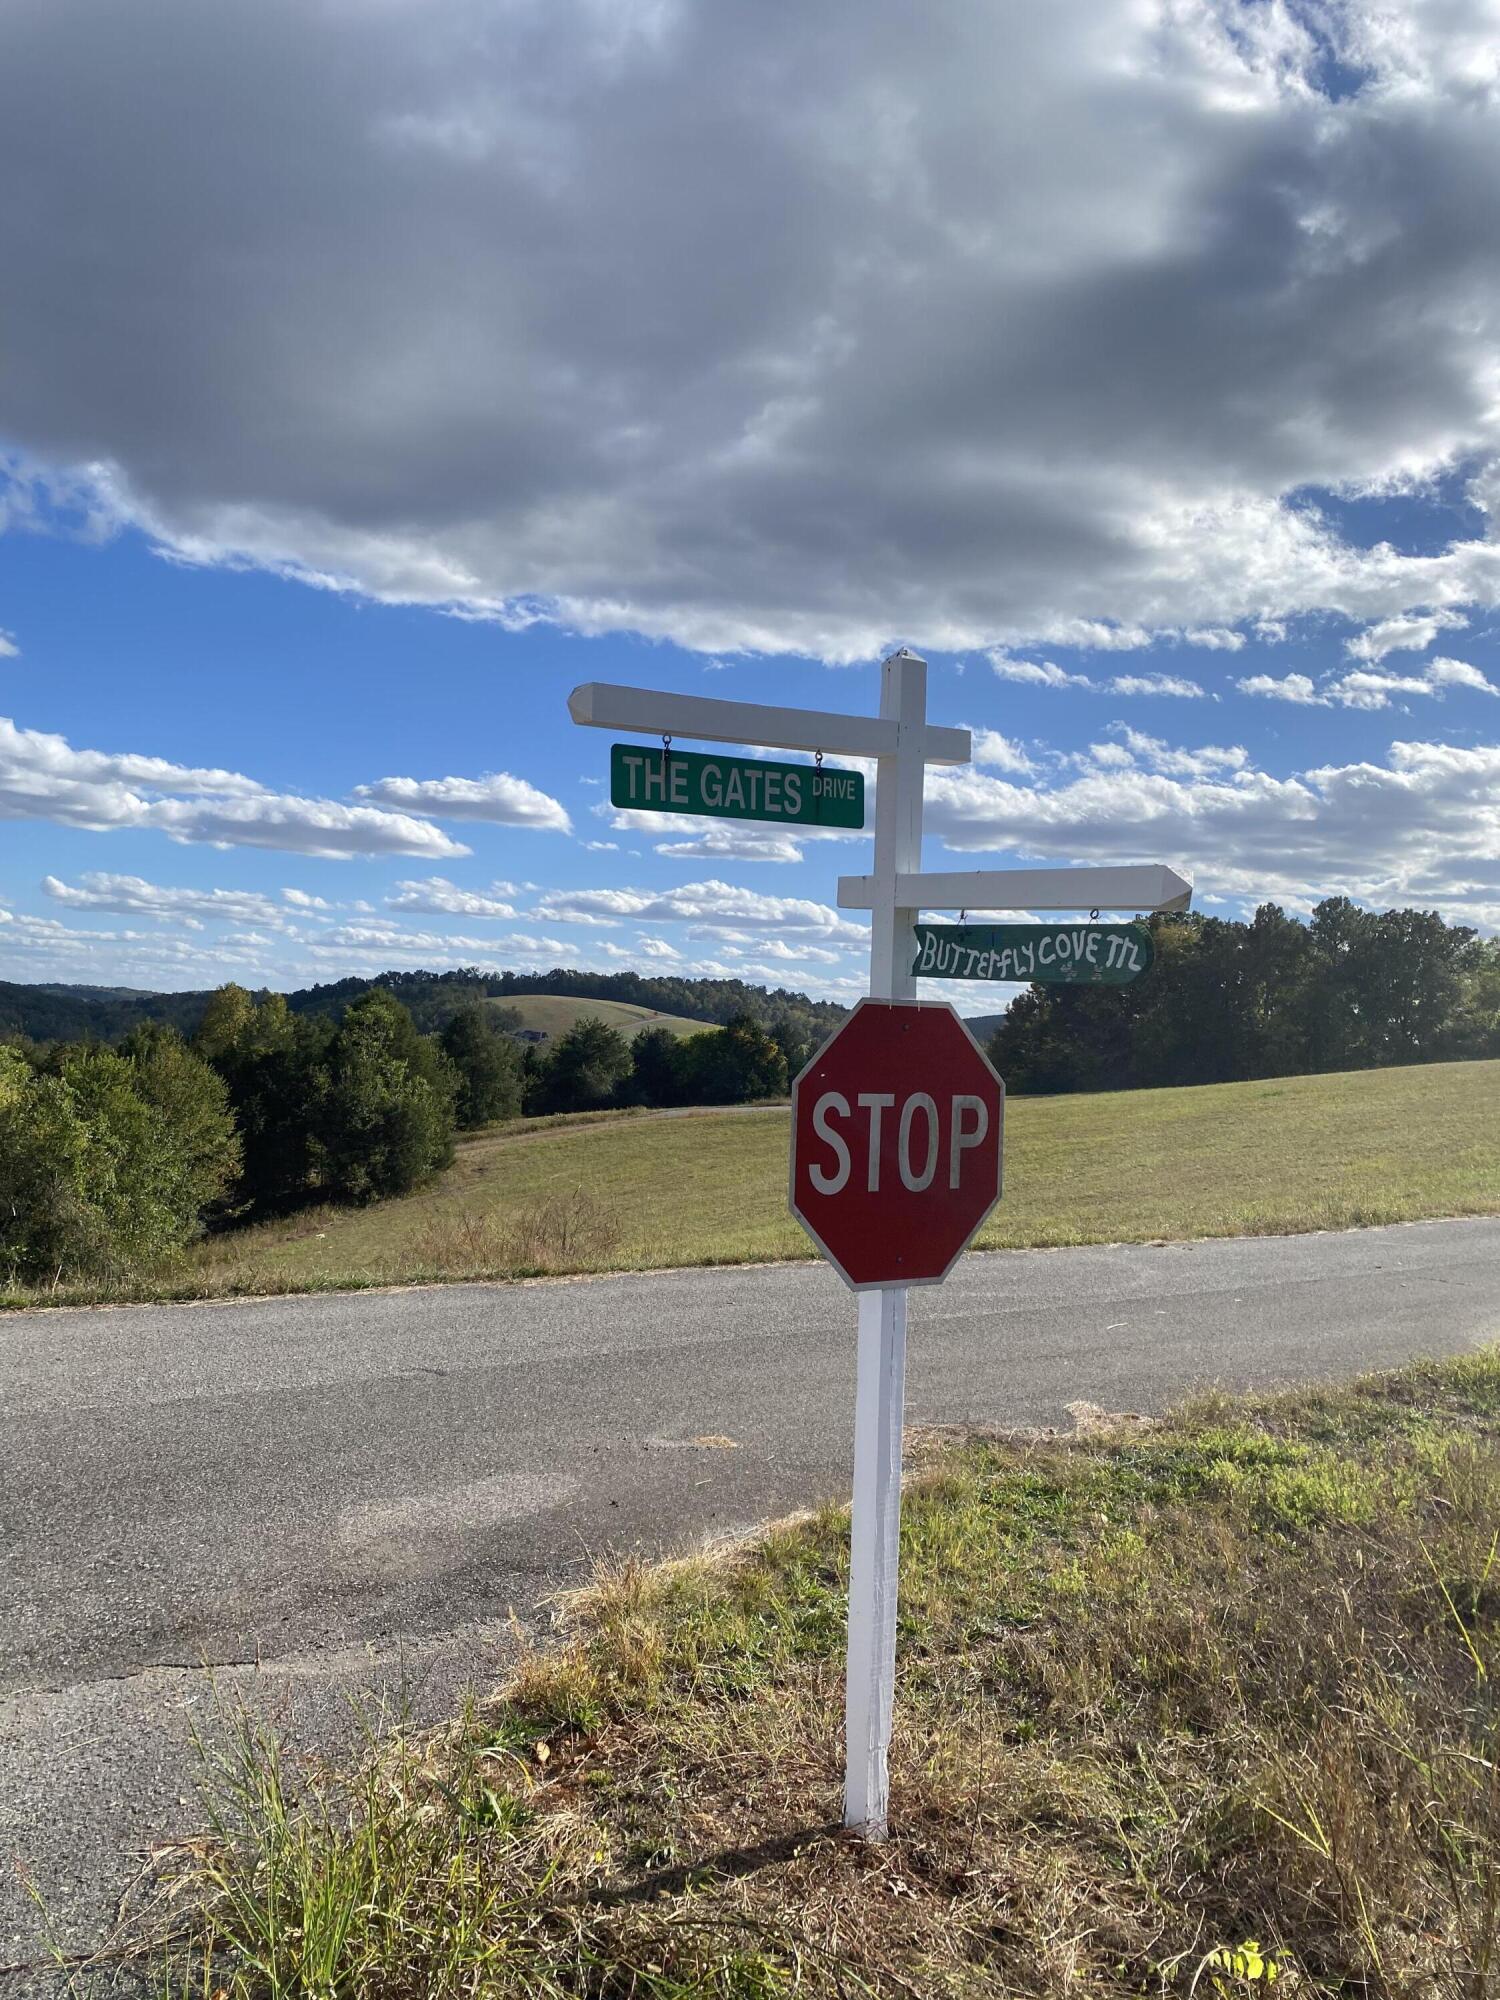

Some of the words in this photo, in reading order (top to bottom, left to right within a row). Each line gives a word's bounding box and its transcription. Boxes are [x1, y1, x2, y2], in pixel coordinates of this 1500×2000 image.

[622, 755, 689, 804] THE
[700, 764, 801, 815] GATES
[811, 776, 856, 800] DRIVE
[1038, 929, 1102, 964] COVE
[808, 1091, 989, 1196] STOP
